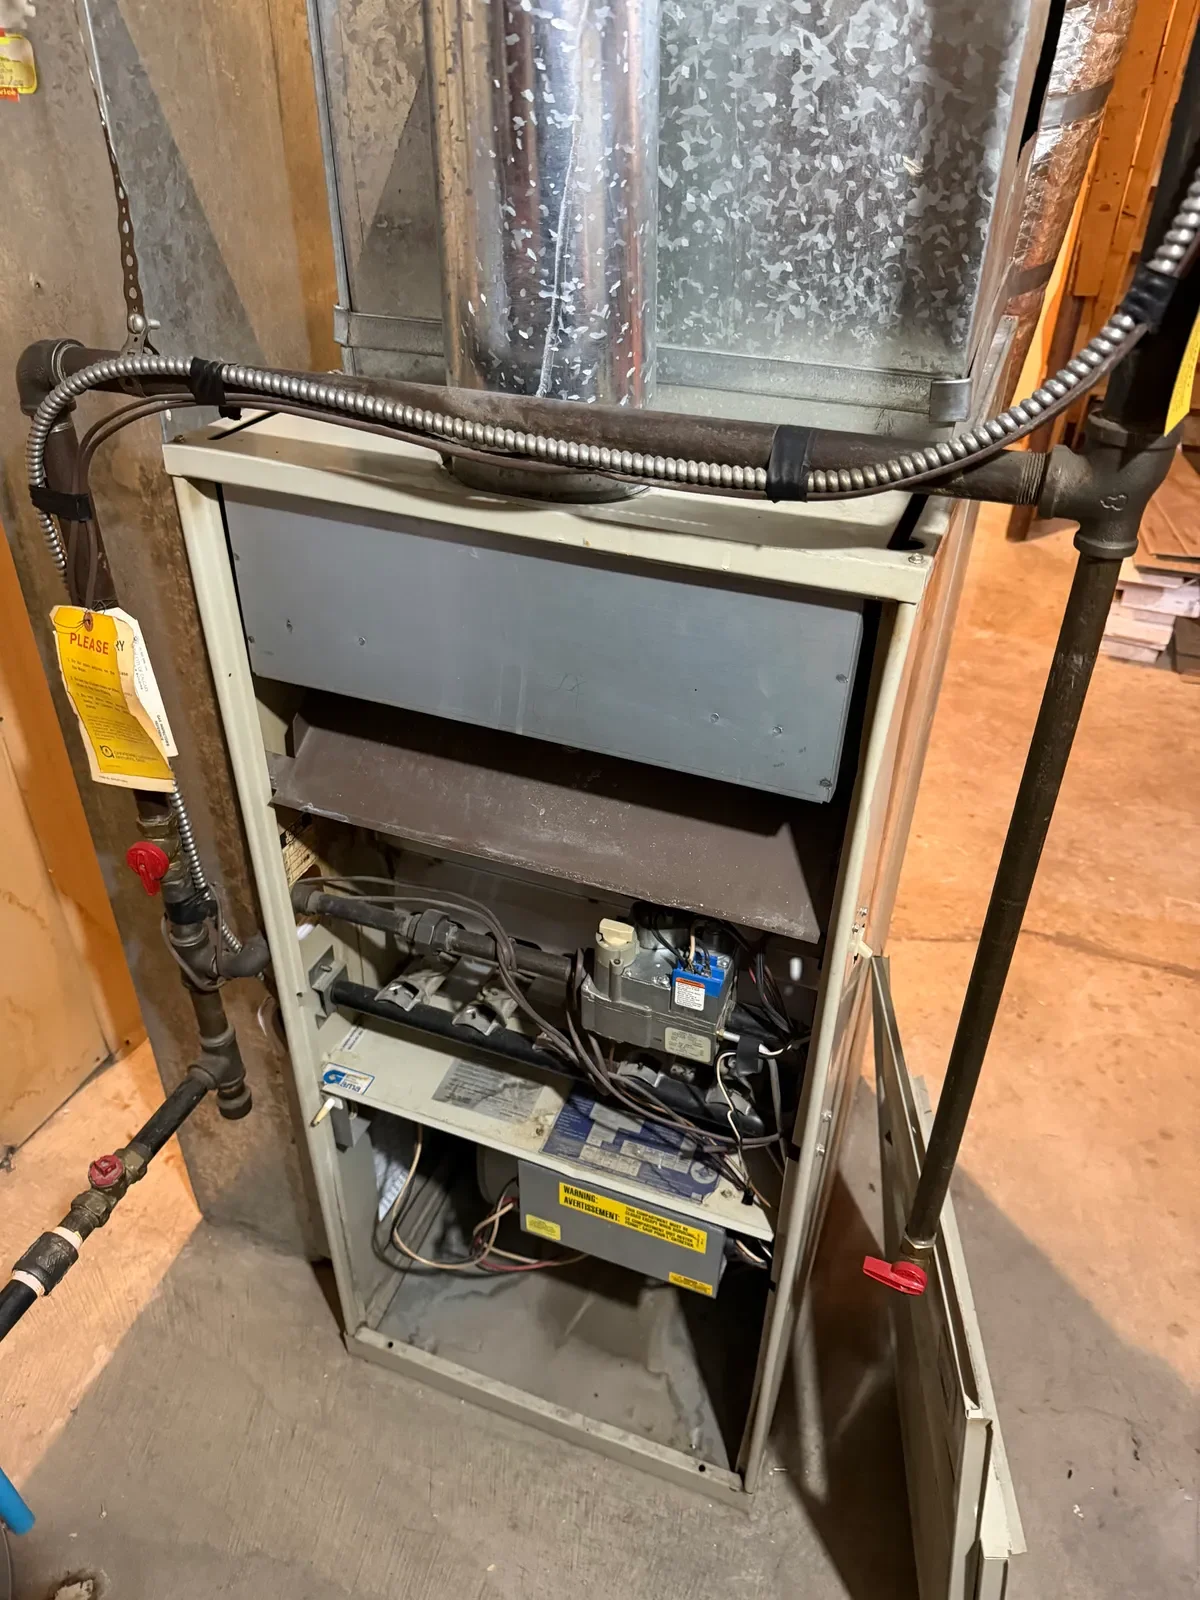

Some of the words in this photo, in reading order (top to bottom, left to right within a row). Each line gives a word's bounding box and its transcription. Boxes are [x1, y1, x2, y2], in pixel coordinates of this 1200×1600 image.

[70, 633, 108, 654] PLEASE
[564, 1185, 598, 1203] WARNING:
[564, 1196, 620, 1222] AVERTISSEMENT:
